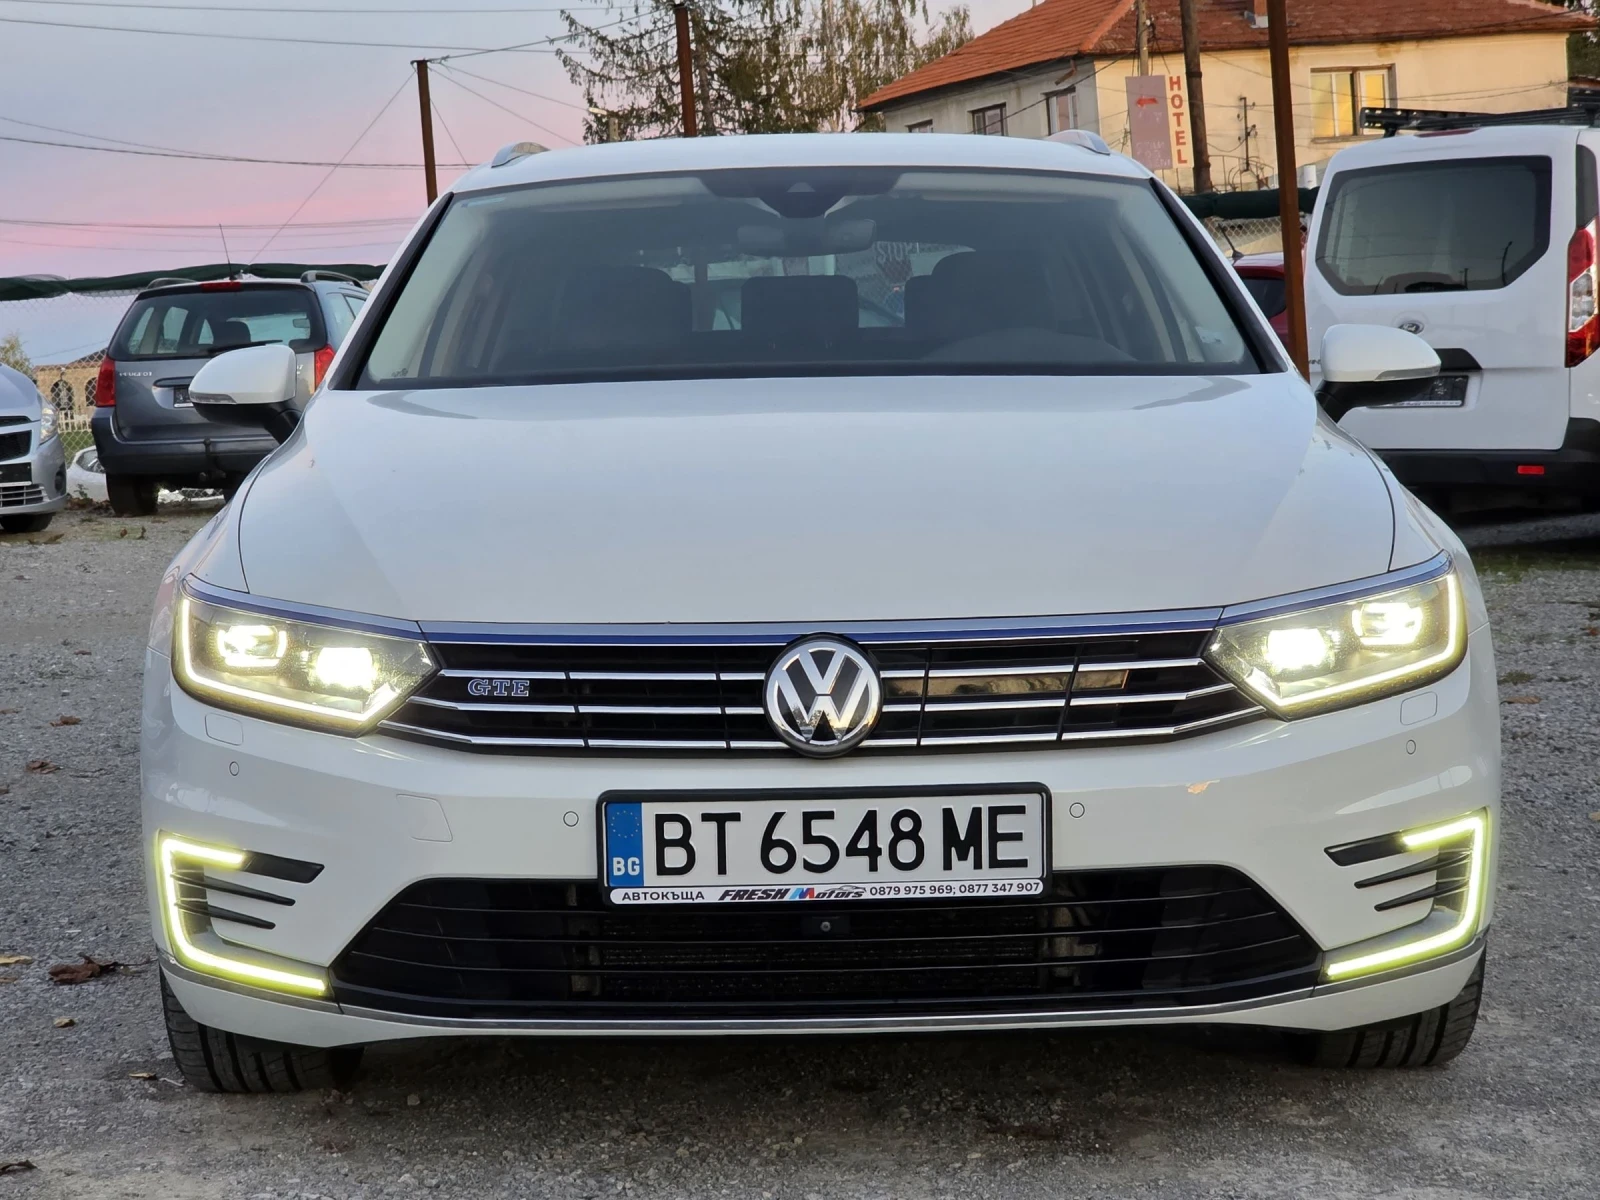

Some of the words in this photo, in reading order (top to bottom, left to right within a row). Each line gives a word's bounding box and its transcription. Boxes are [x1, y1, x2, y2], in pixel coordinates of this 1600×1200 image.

[1169, 75, 1187, 165] HOTEL
[467, 678, 530, 697] GTE
[654, 812, 742, 876] BT
[760, 807, 926, 874] 6548
[941, 804, 1029, 871] ME
[612, 857, 641, 876] BG
[621, 890, 705, 902] АВТОКЪЩА
[717, 887, 792, 901] FRESH
[788, 887, 865, 900] Motors
[869, 885, 901, 896] 0879
[903, 885, 926, 896] 975
[929, 883, 956, 896] 969;
[958, 883, 989, 894] 0877
[991, 882, 1013, 893] 347
[1016, 881, 1040, 893] 907
